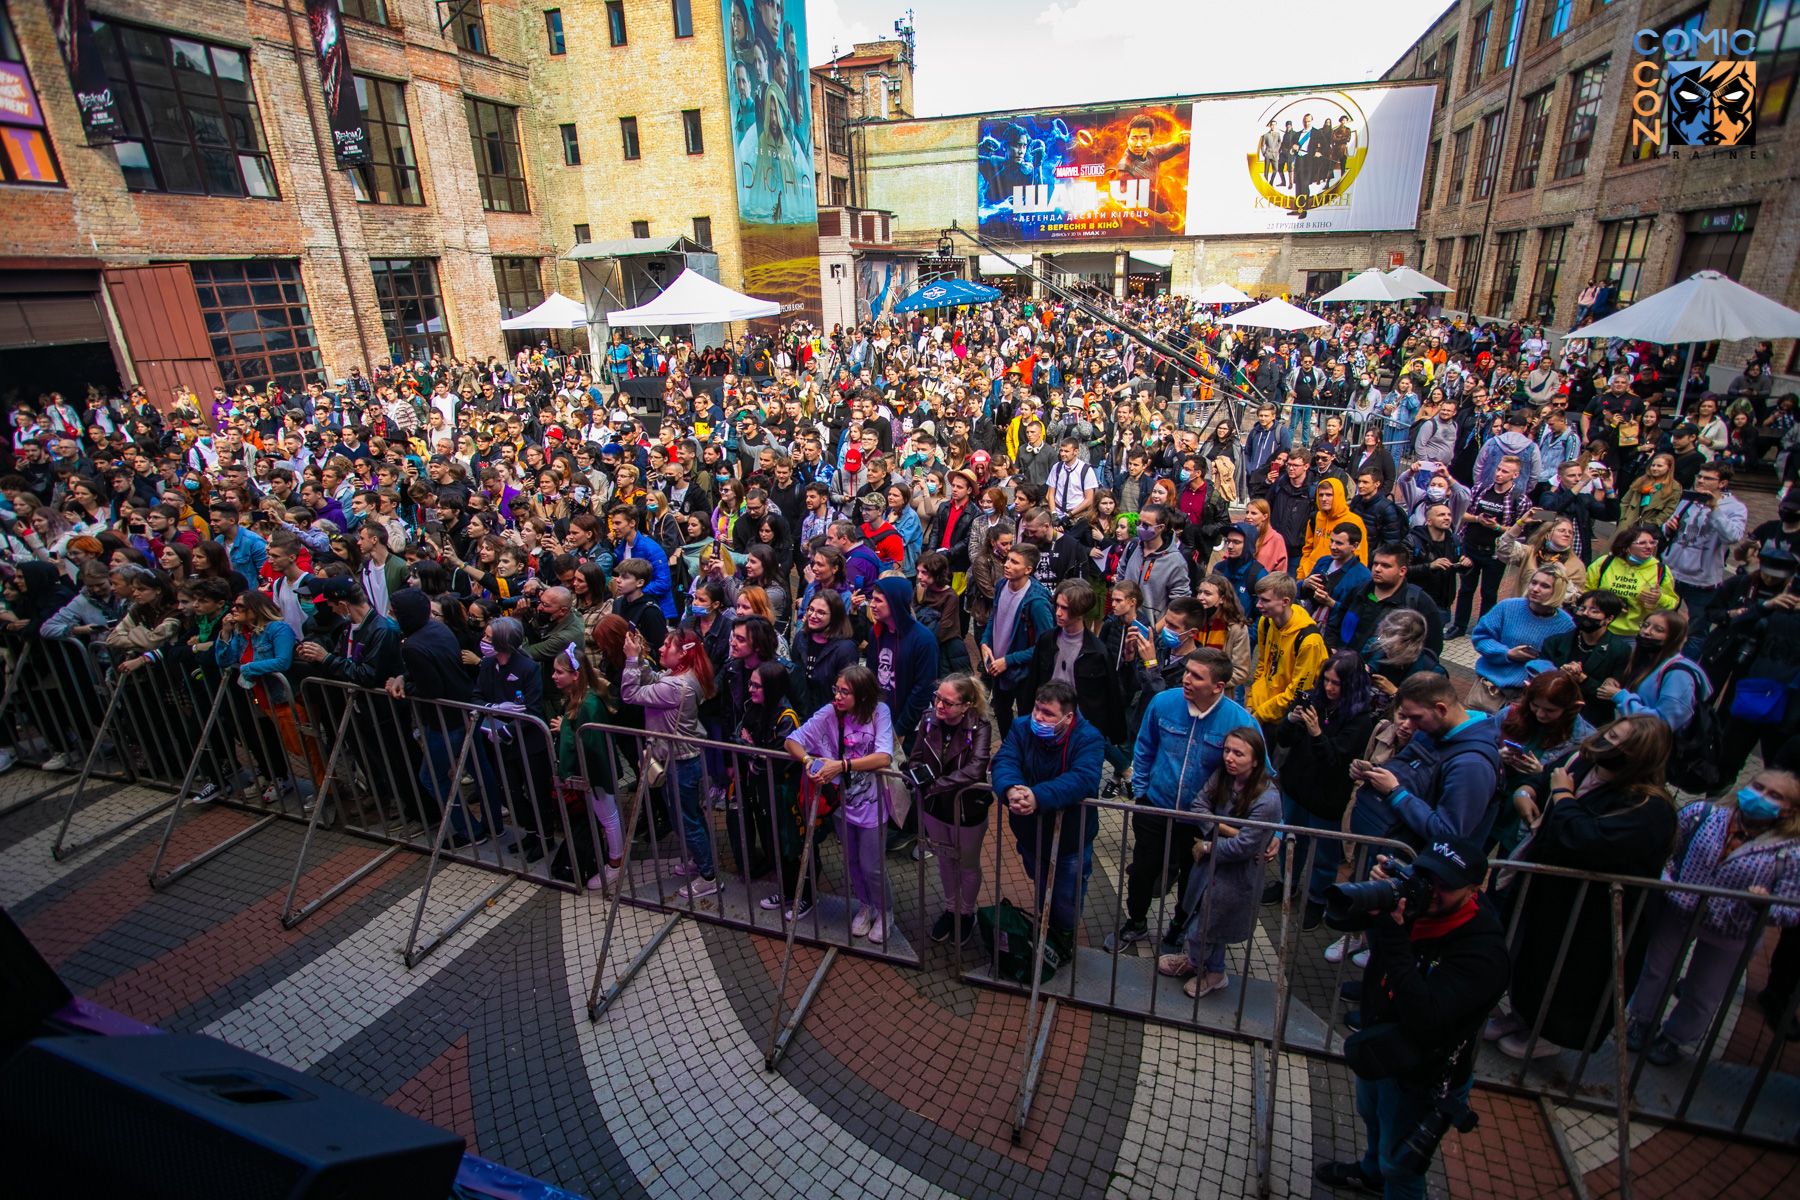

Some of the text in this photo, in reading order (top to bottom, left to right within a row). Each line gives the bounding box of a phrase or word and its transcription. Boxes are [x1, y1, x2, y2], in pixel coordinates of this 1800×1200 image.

[1056, 164, 1105, 177] MARVEL STUDIOS
[1047, 223, 1087, 231] ВЕРЕСНЯ
[1098, 221, 1119, 229] КІНО
